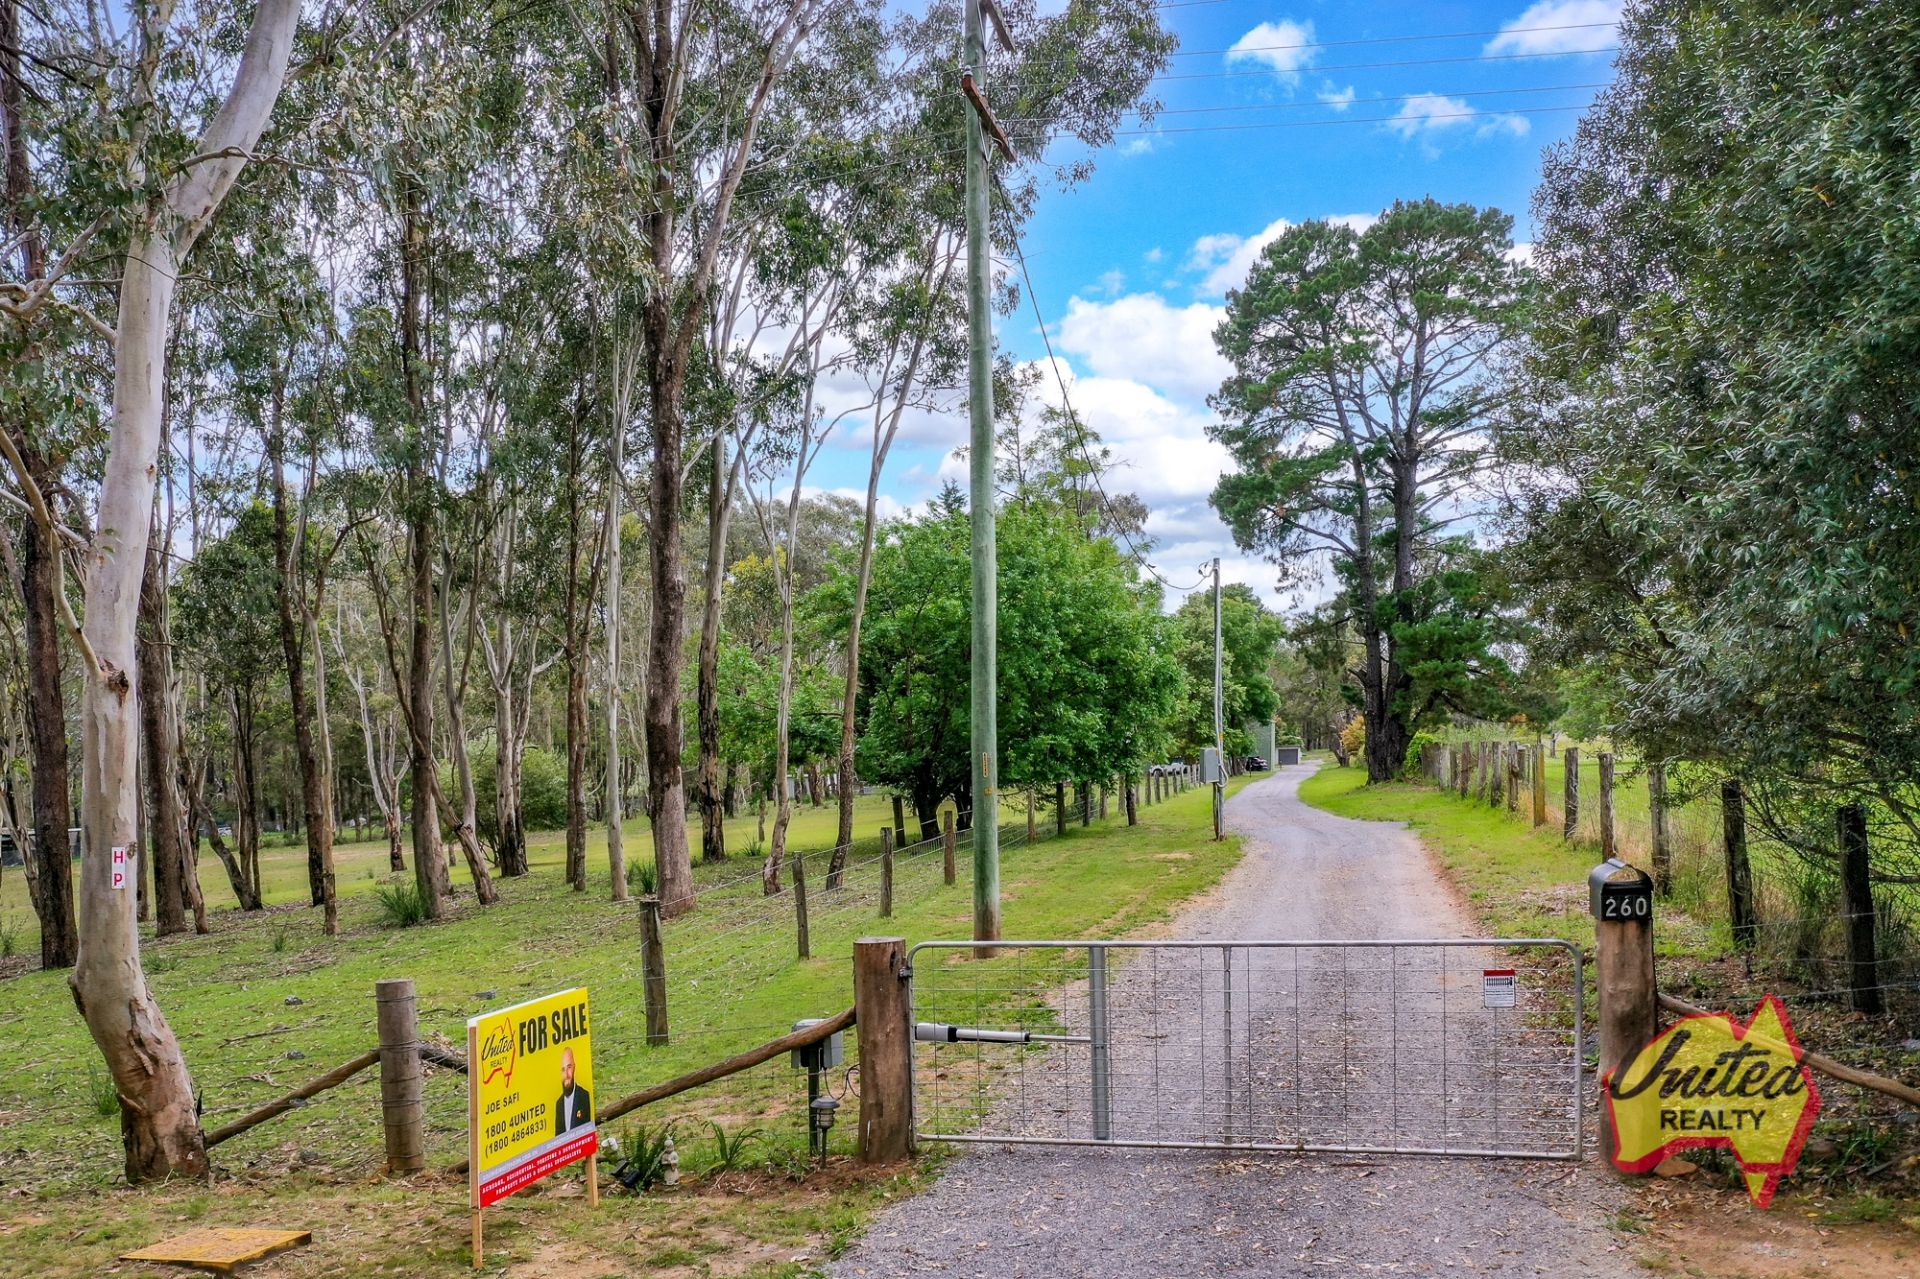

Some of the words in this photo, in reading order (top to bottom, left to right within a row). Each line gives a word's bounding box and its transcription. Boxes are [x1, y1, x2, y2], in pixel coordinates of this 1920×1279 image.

[1605, 897, 1647, 917] 260
[481, 1030, 516, 1061] United
[519, 1015, 548, 1057] FOR
[552, 1003, 587, 1045] SALE
[490, 1056, 508, 1067] REALTY
[485, 1099, 501, 1115] JOE
[503, 1092, 520, 1107] SAFI
[485, 1120, 507, 1139] 1800
[509, 1103, 546, 1127] 4UNITED
[485, 1136, 509, 1159] (1800
[511, 1118, 547, 1142] 4864833)
